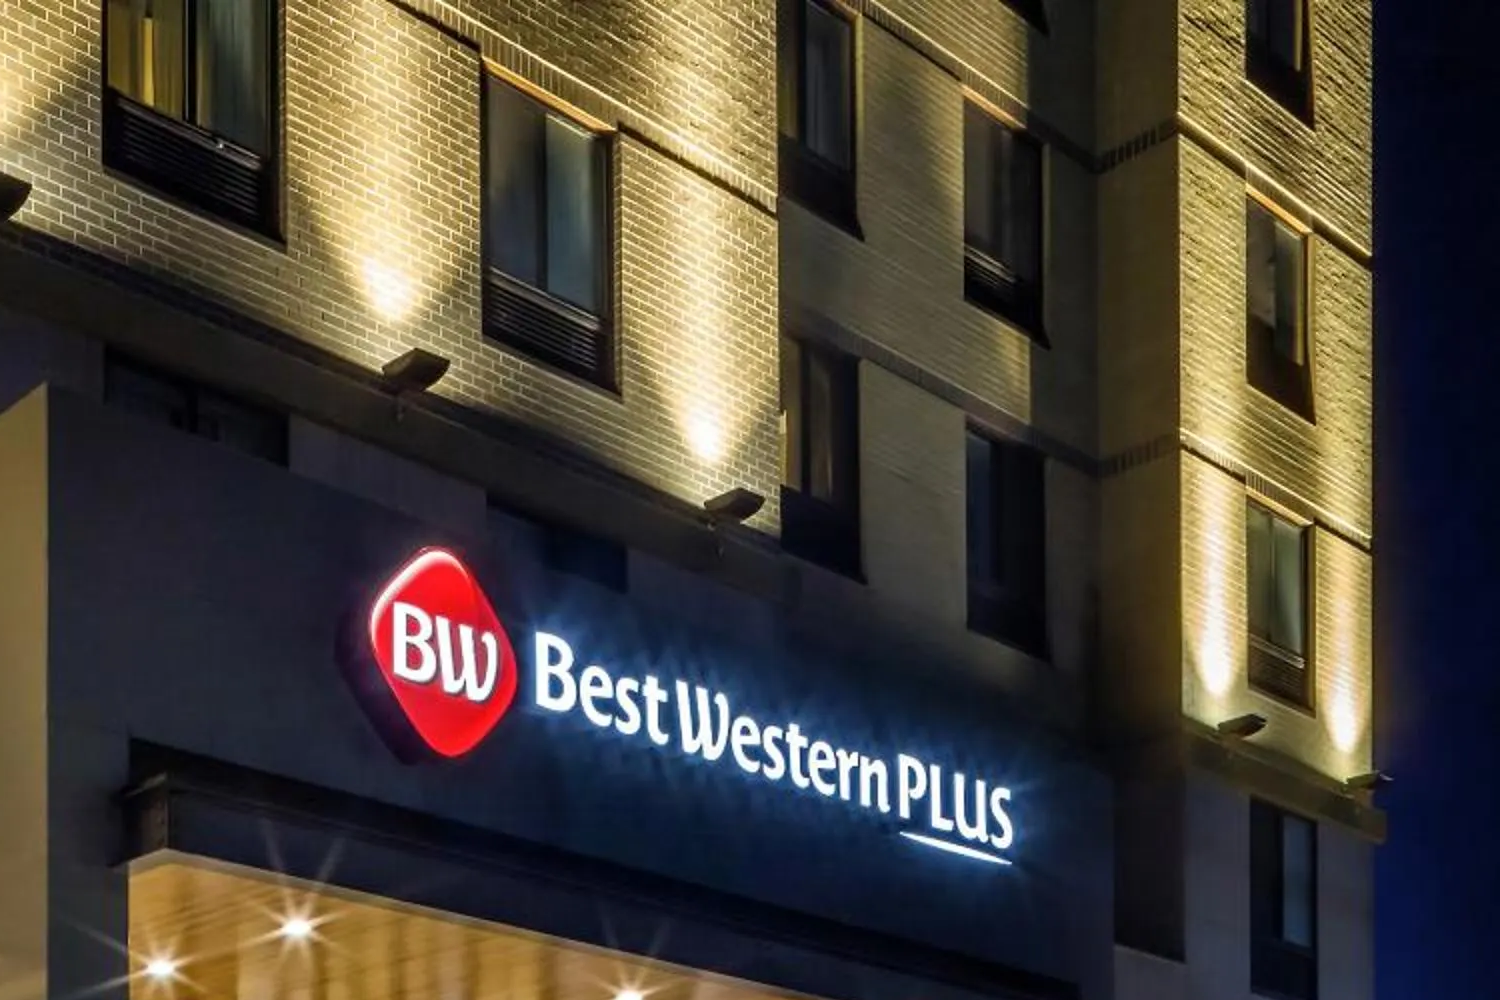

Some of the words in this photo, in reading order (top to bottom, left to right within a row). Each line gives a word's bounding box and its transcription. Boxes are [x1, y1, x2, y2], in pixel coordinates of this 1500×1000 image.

[392, 602, 498, 702] BW
[534, 631, 670, 746] Best
[675, 679, 892, 814] Western
[898, 753, 1014, 850] PLUS
